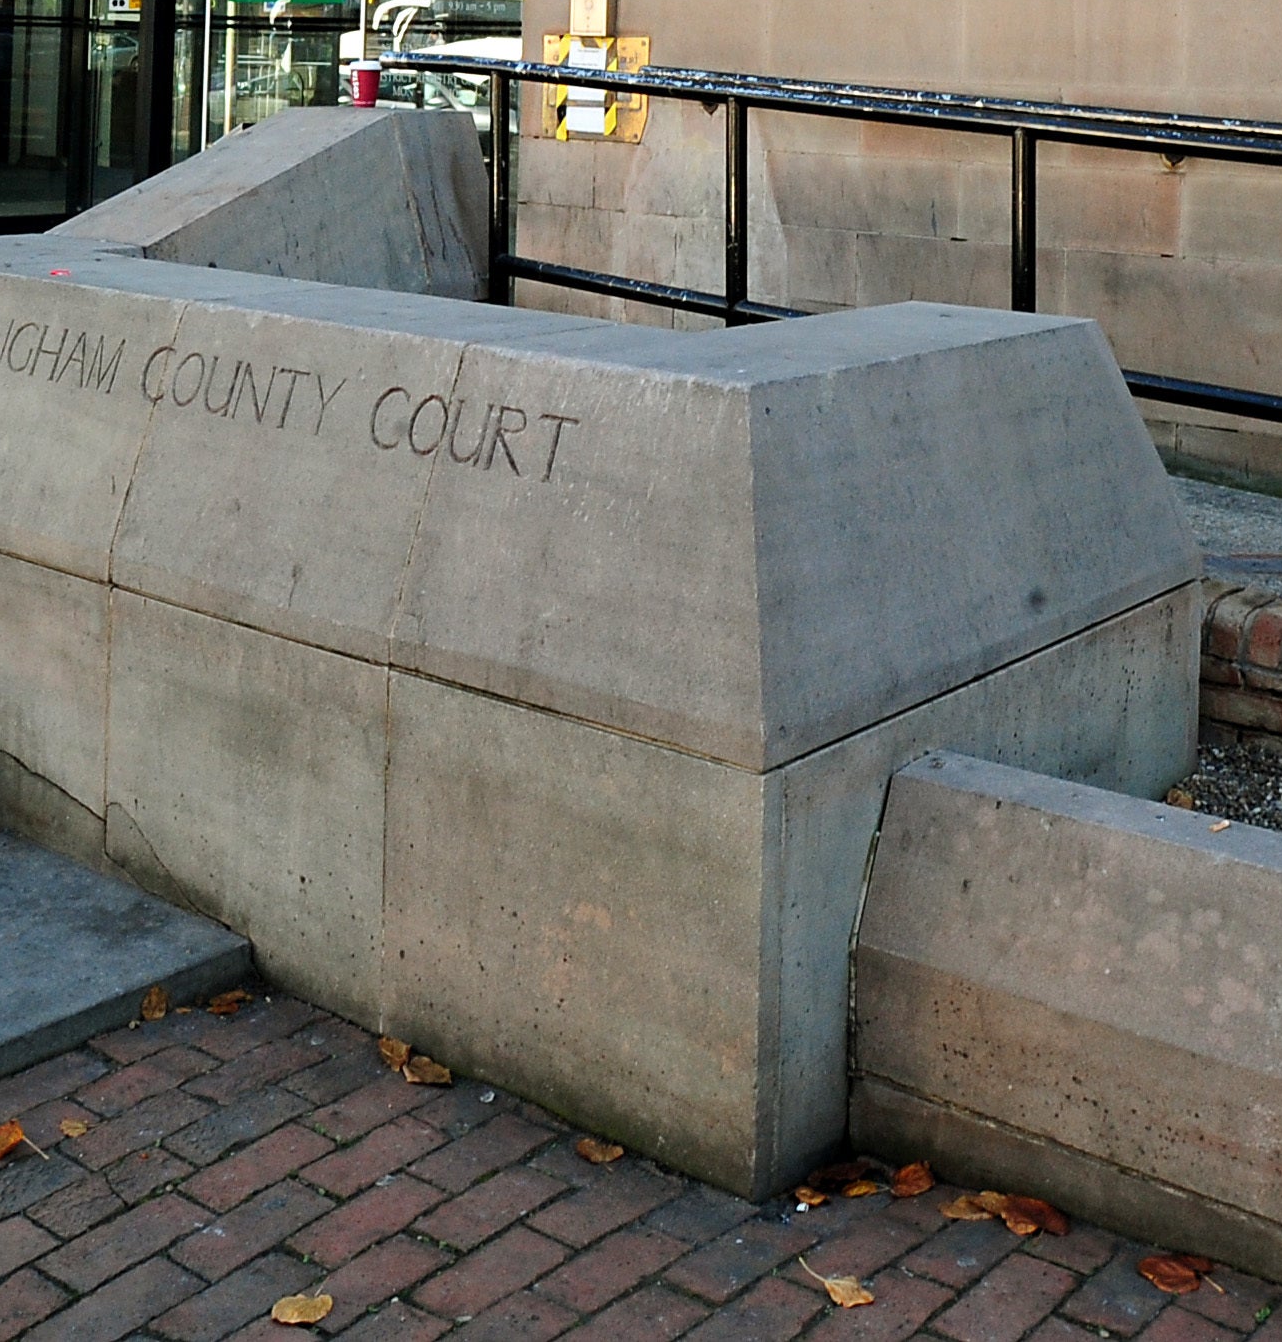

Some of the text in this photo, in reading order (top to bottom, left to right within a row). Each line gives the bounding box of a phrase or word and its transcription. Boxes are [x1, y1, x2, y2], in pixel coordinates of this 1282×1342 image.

[466, 3, 477, 11] am
[493, 3, 506, 14] pm
[380, 73, 413, 83] ISTRICT
[139, 345, 349, 436] COUNTY
[369, 386, 580, 483] COURT
